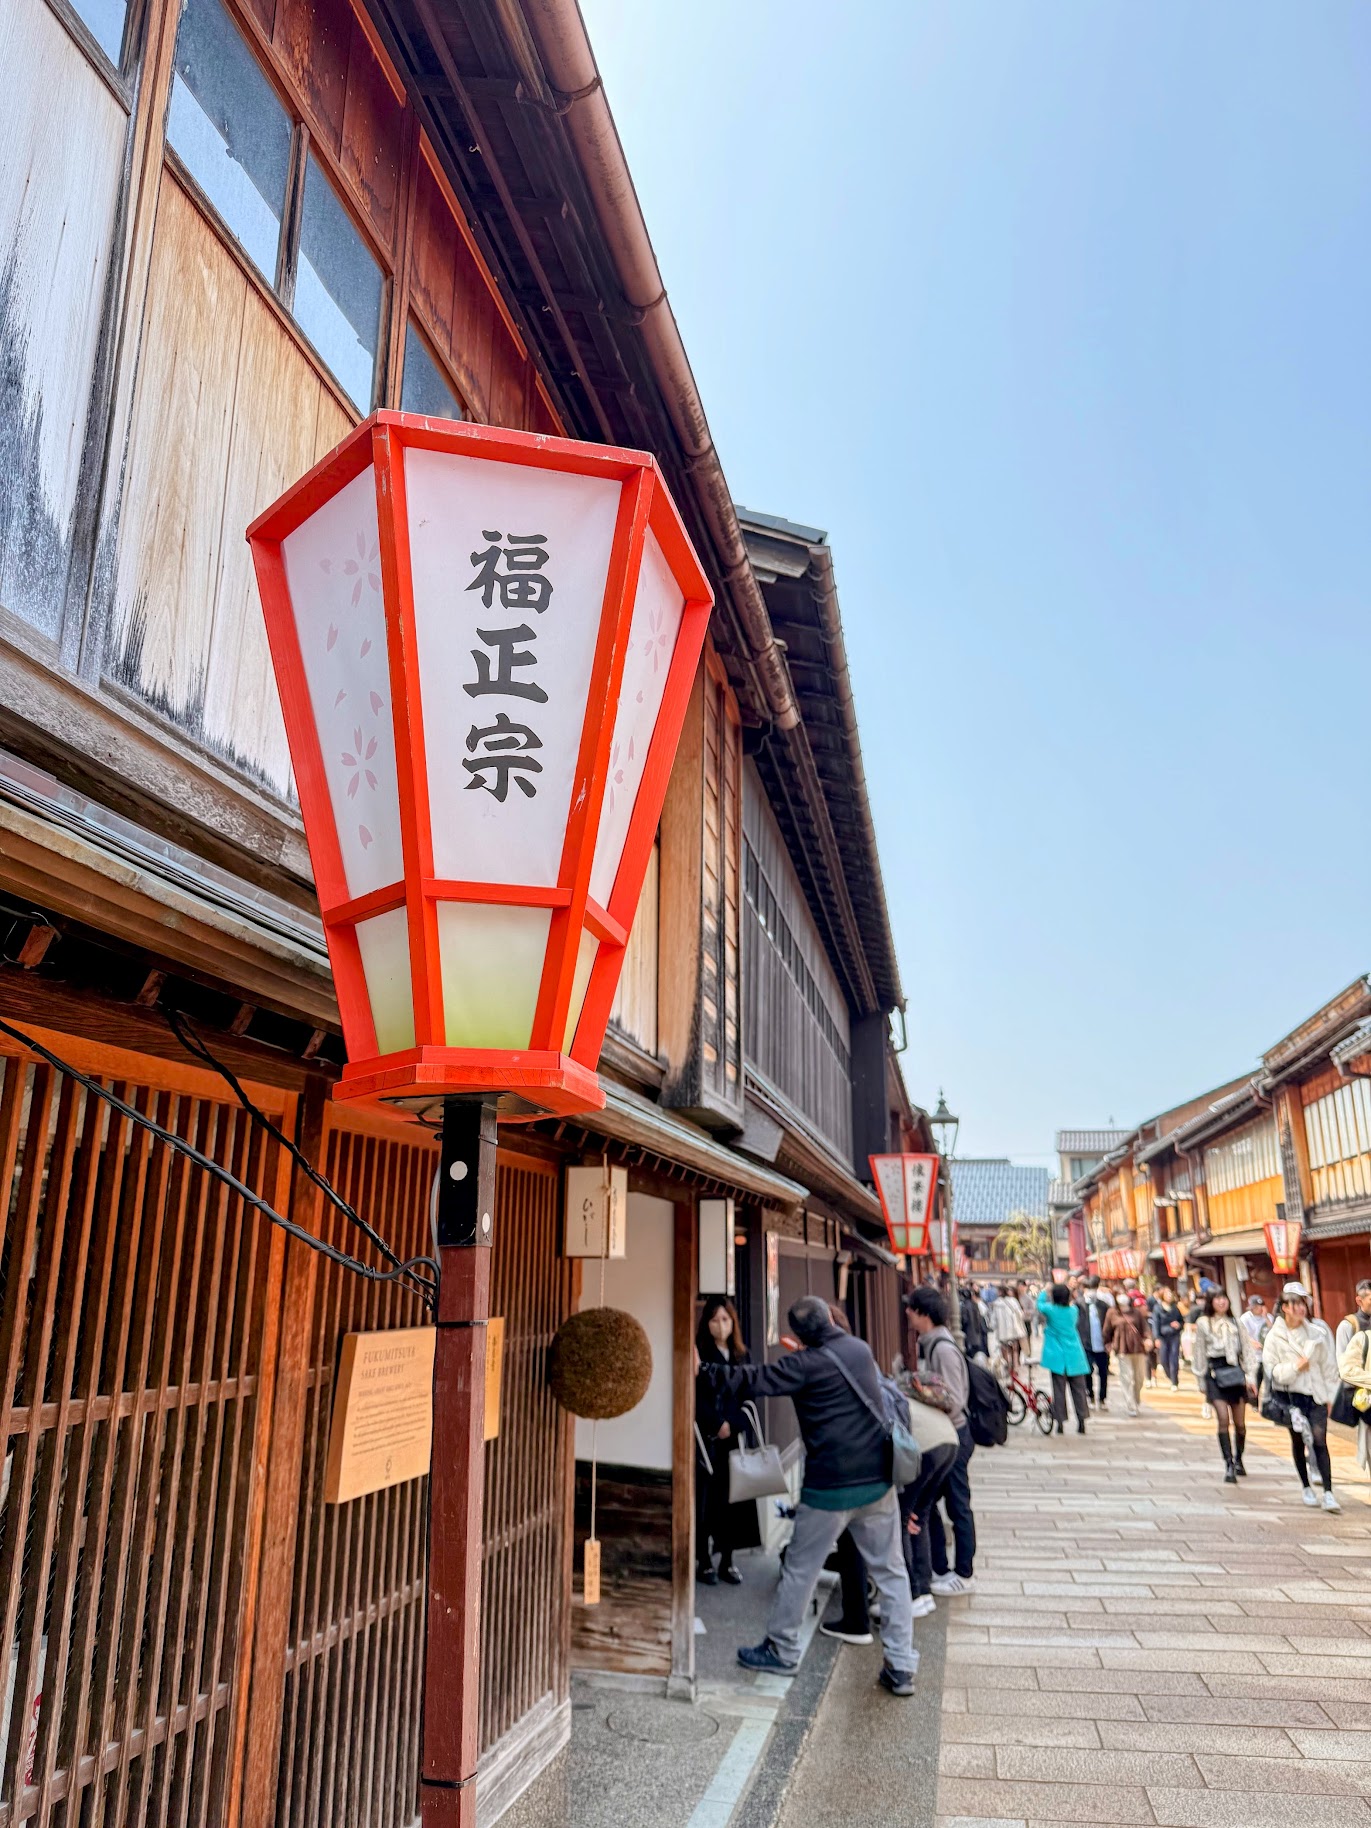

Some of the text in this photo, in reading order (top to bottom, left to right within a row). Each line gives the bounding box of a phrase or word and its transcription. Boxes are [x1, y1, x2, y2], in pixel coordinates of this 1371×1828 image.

[462, 529, 553, 803] 福正宗
[361, 1364, 404, 1379] SAKE BREWERY
